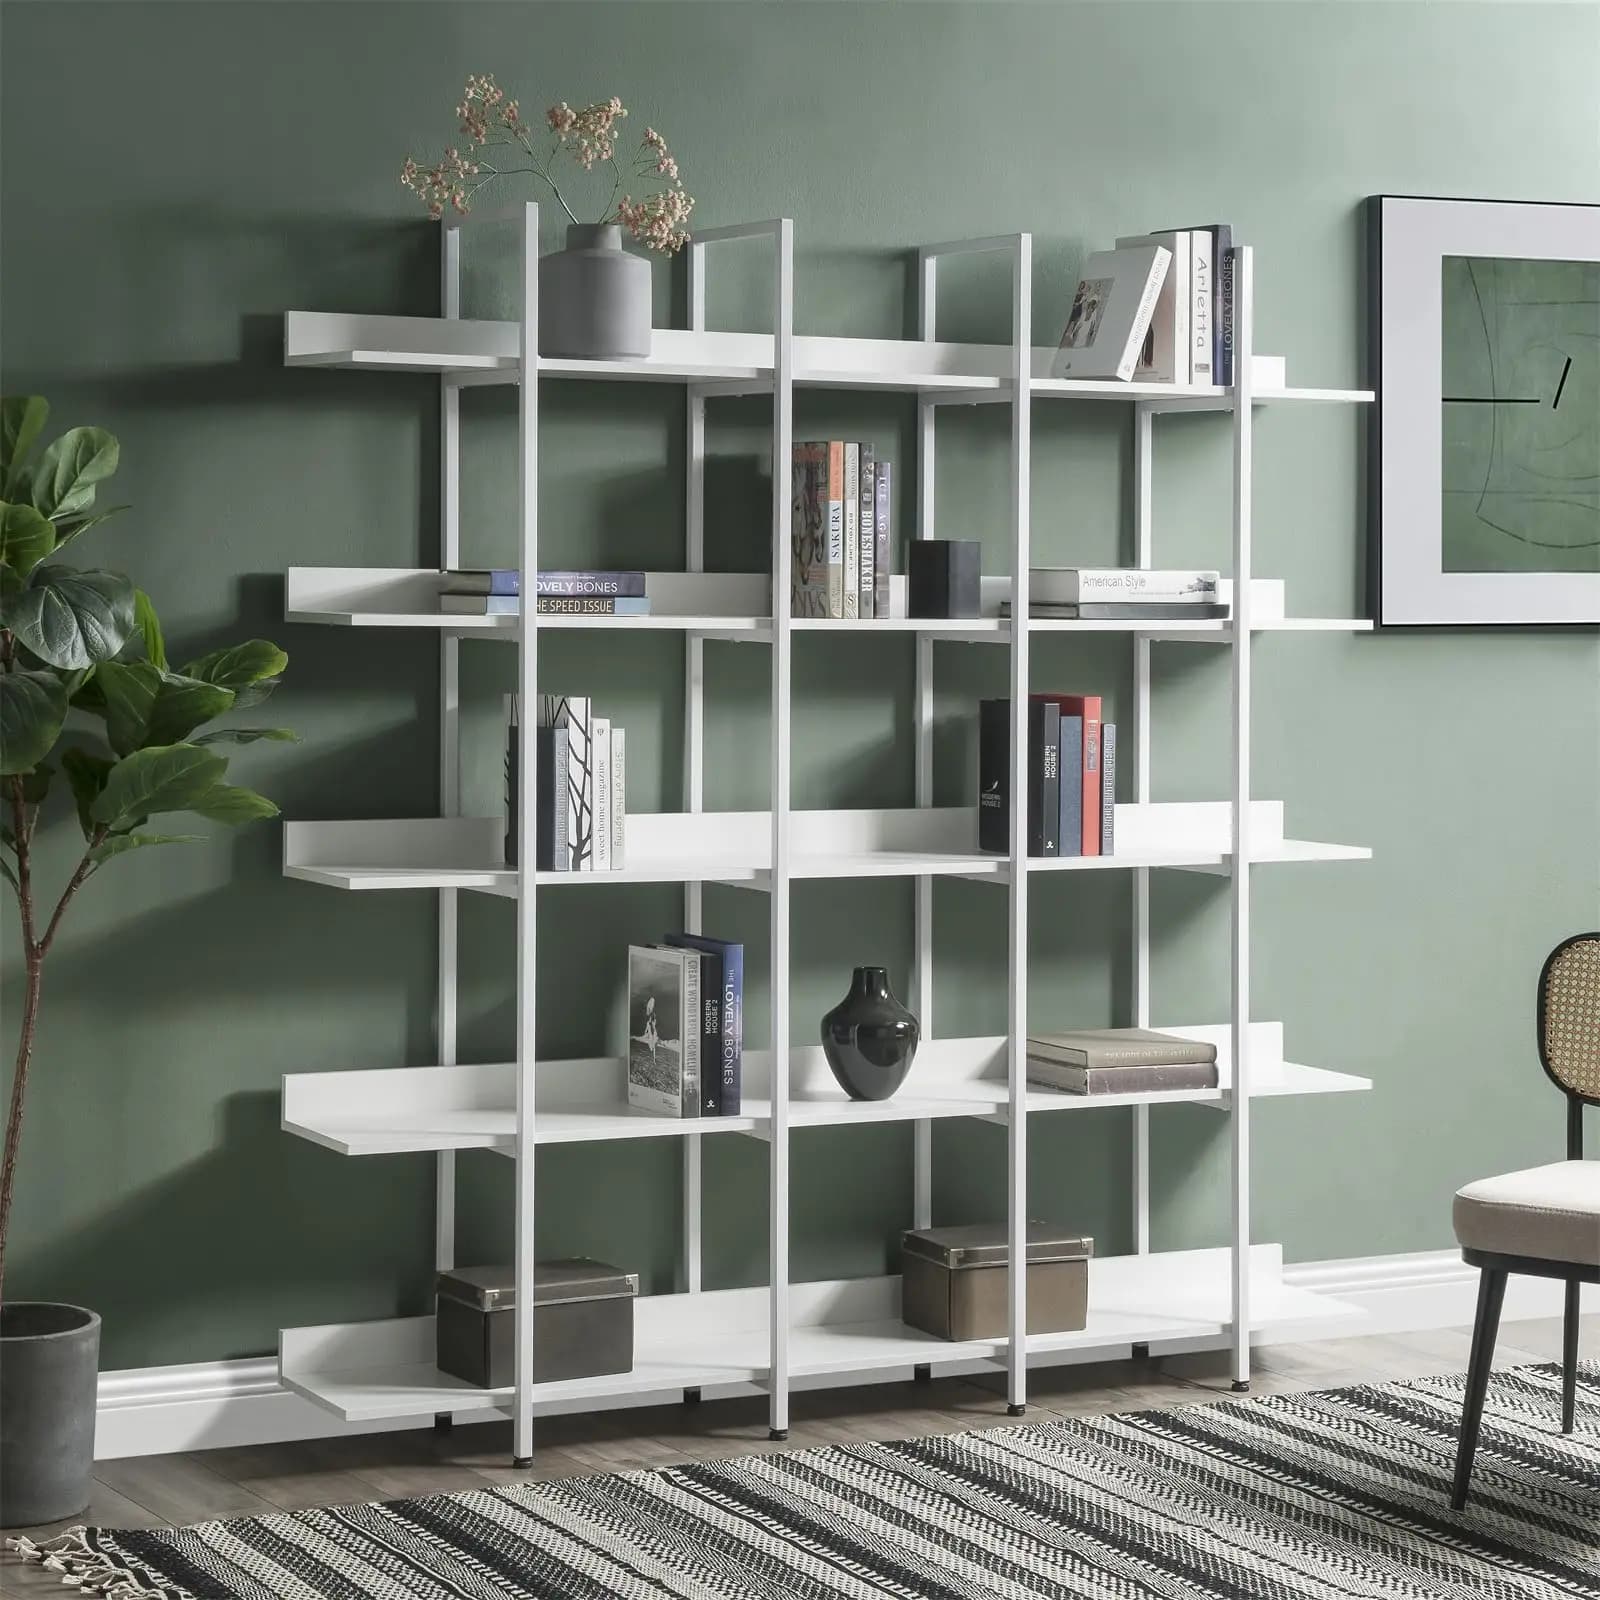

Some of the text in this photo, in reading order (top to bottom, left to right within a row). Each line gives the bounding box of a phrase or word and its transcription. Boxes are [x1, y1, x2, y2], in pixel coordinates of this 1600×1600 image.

[1223, 255, 1232, 299] BONES
[1196, 256, 1208, 348] Arletta
[1224, 303, 1232, 350] LOVELY
[831, 506, 840, 558] SAKURA
[879, 476, 887, 542] ICE AGE
[861, 511, 873, 592] BONESHAKER
[576, 582, 618, 593] BONES
[1083, 575, 1146, 589] American Style
[549, 600, 581, 613] SPEED
[582, 600, 613, 613] ISSUE
[599, 760, 607, 804] magazine
[687, 960, 697, 987] CREATE
[687, 989, 697, 1036] WONDERFUL
[724, 984, 735, 1036] LOVELY
[723, 1039, 734, 1085] BONES
